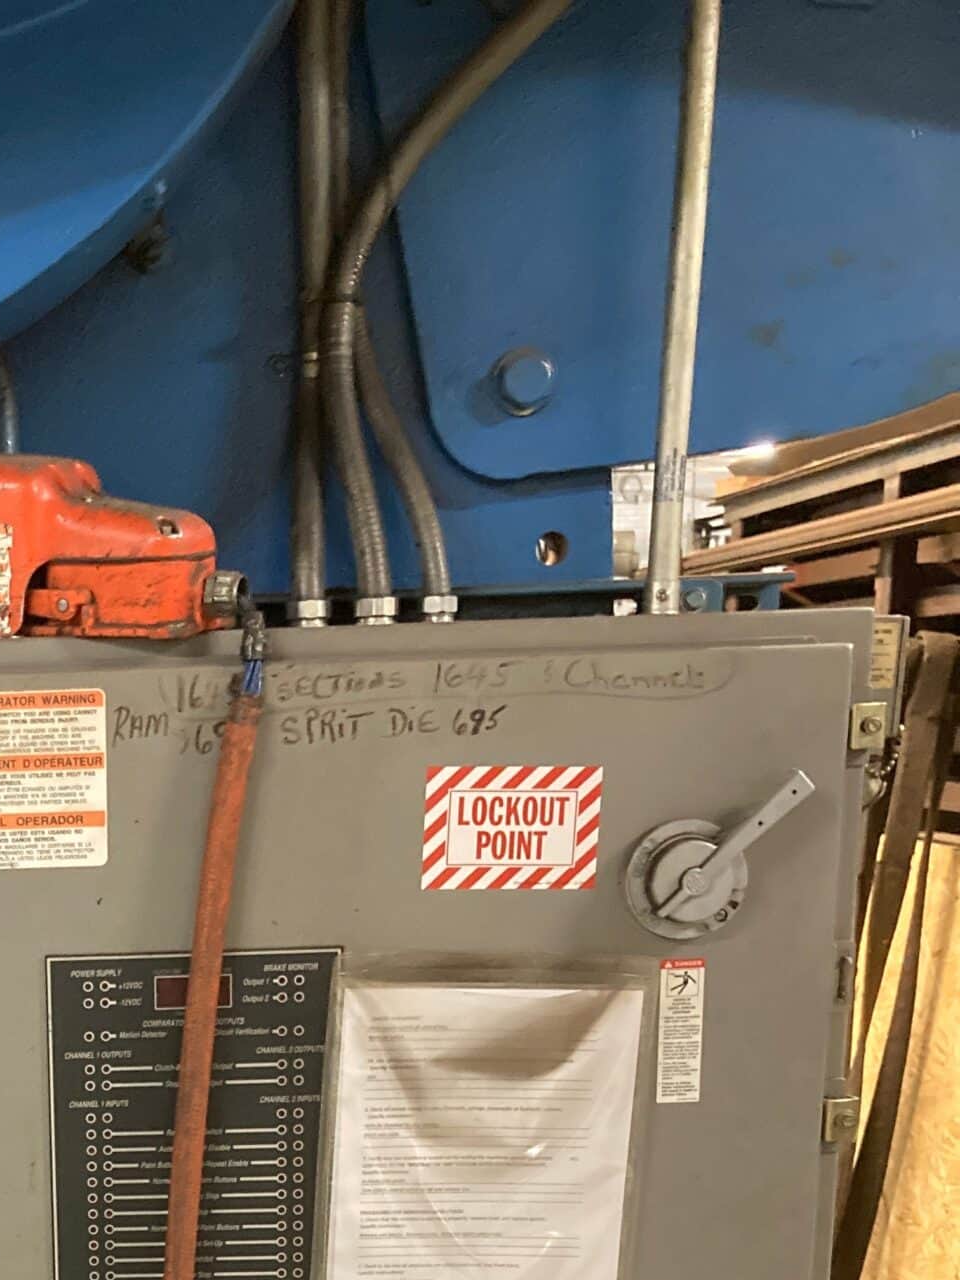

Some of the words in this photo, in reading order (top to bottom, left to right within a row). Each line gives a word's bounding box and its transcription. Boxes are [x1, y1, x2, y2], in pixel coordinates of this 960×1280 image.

[42, 694, 96, 705] WARNING
[112, 706, 169, 748] RAM
[457, 795, 570, 826] LOCKOUT
[16, 815, 84, 826] OPERADOR
[475, 830, 548, 860] POINT
[70, 969, 95, 978] POWER
[96, 968, 122, 977] SUPPLY
[64, 1051, 95, 1060] CHANNEL
[101, 1050, 132, 1059] OUTPUTS
[69, 1100, 99, 1109] CHANNEL
[105, 1099, 129, 1108] INPUTS
